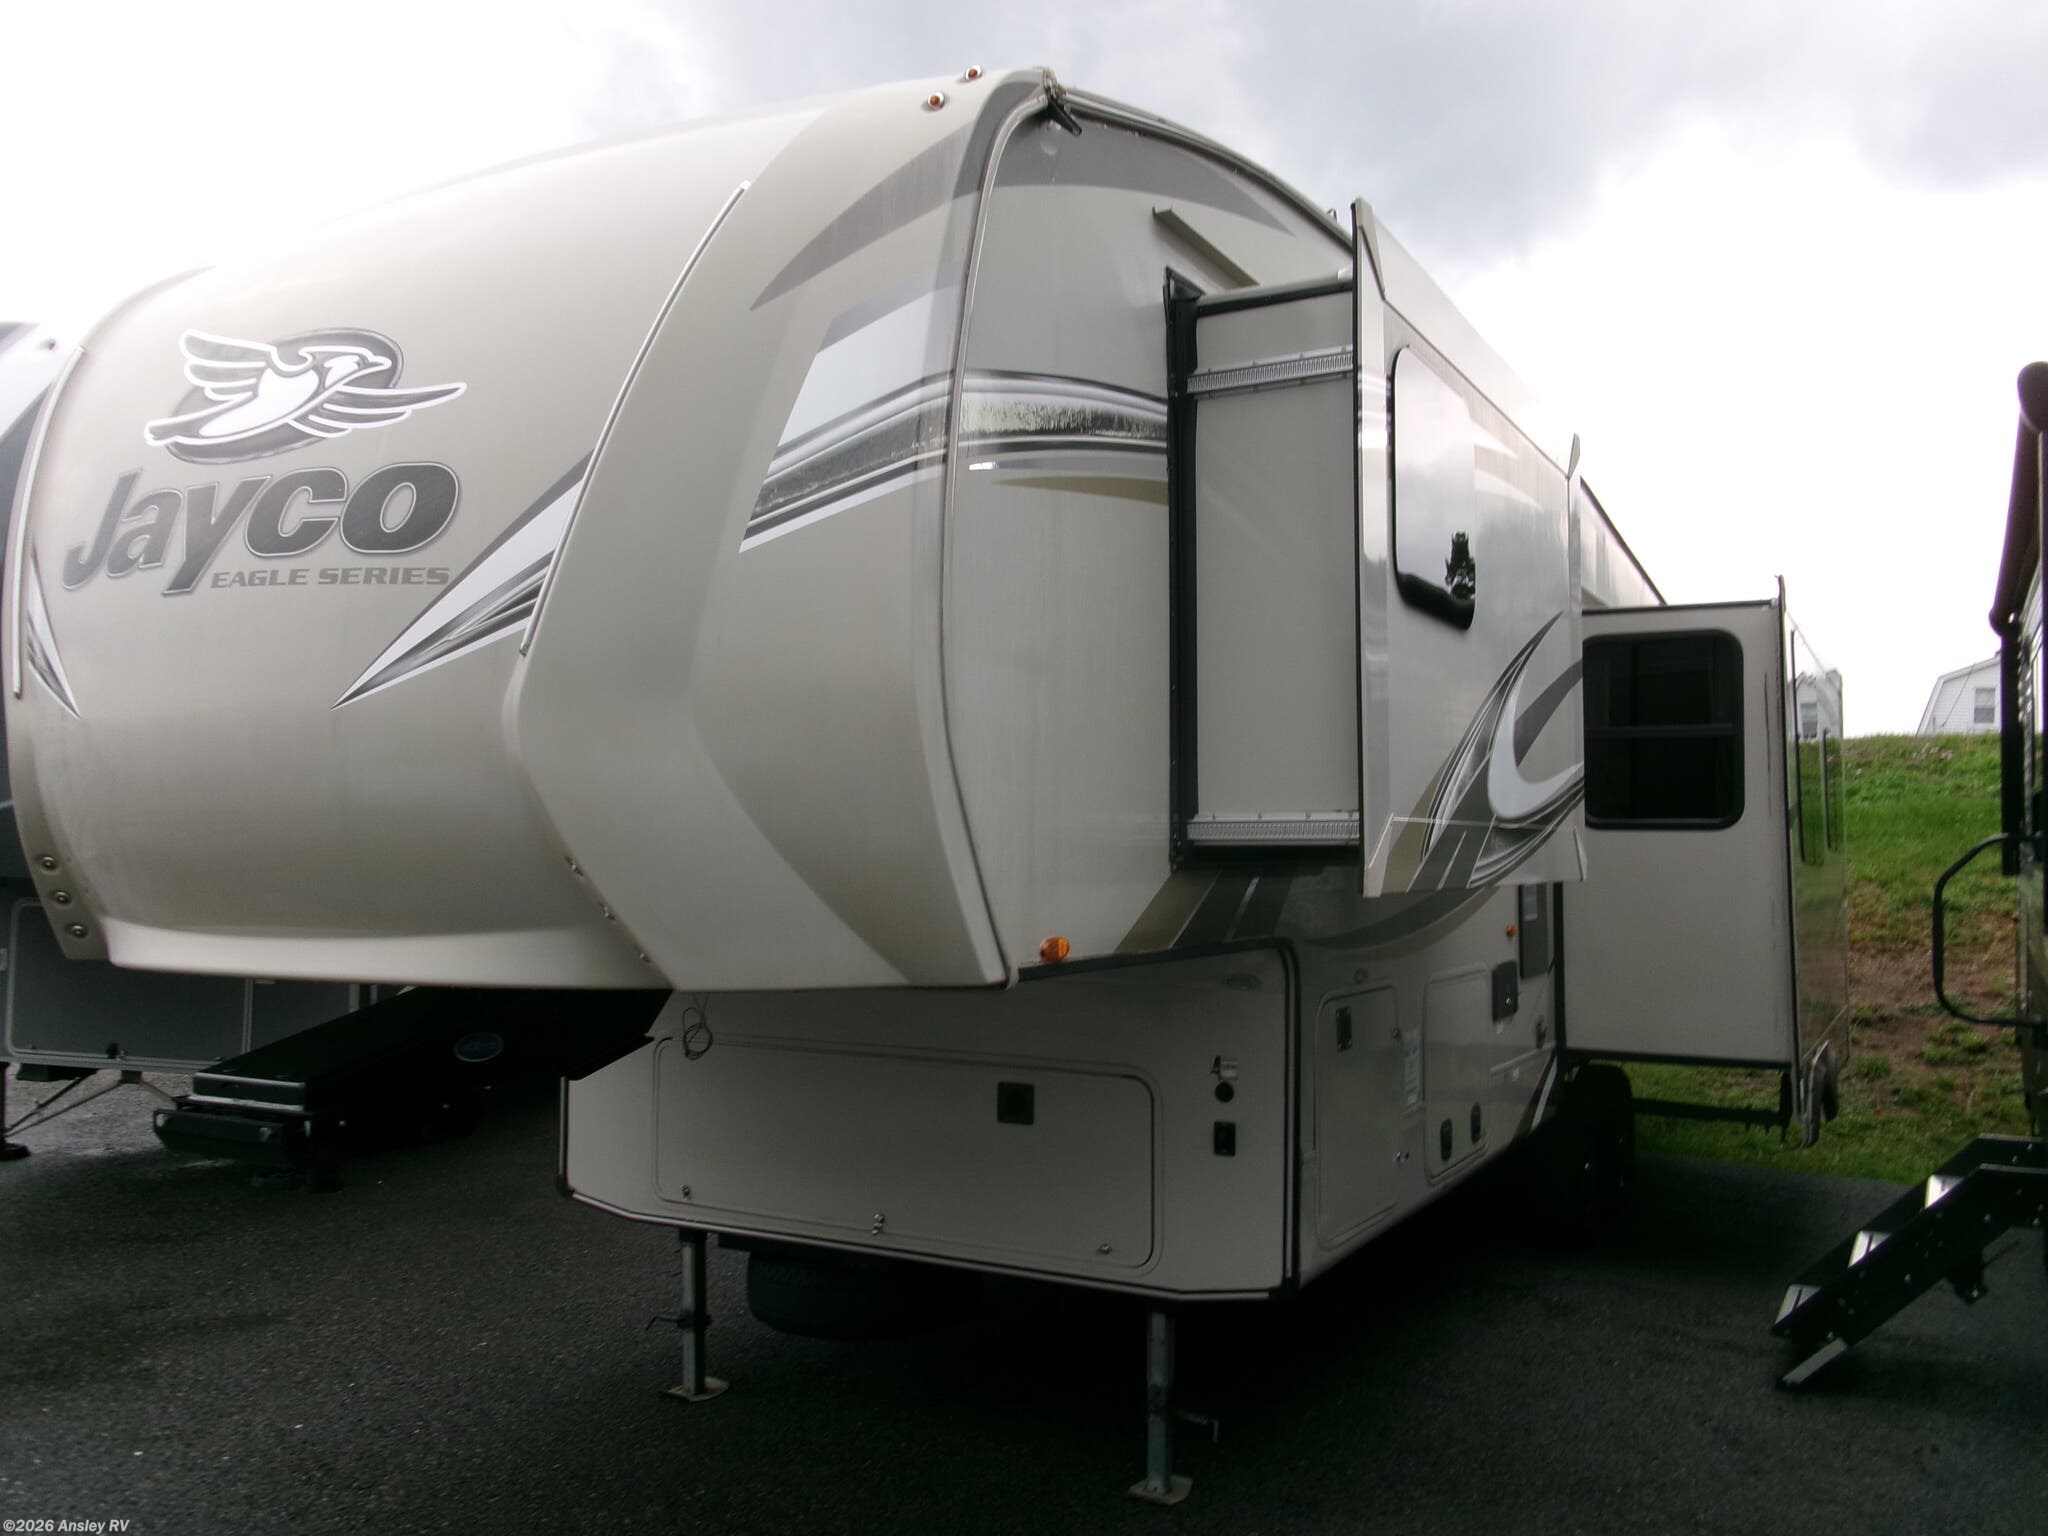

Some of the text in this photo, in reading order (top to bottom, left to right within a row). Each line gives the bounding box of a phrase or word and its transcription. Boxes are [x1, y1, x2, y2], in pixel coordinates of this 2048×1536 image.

[62, 463, 459, 596] Jayco
[210, 566, 450, 588] EAGLE SERIES
